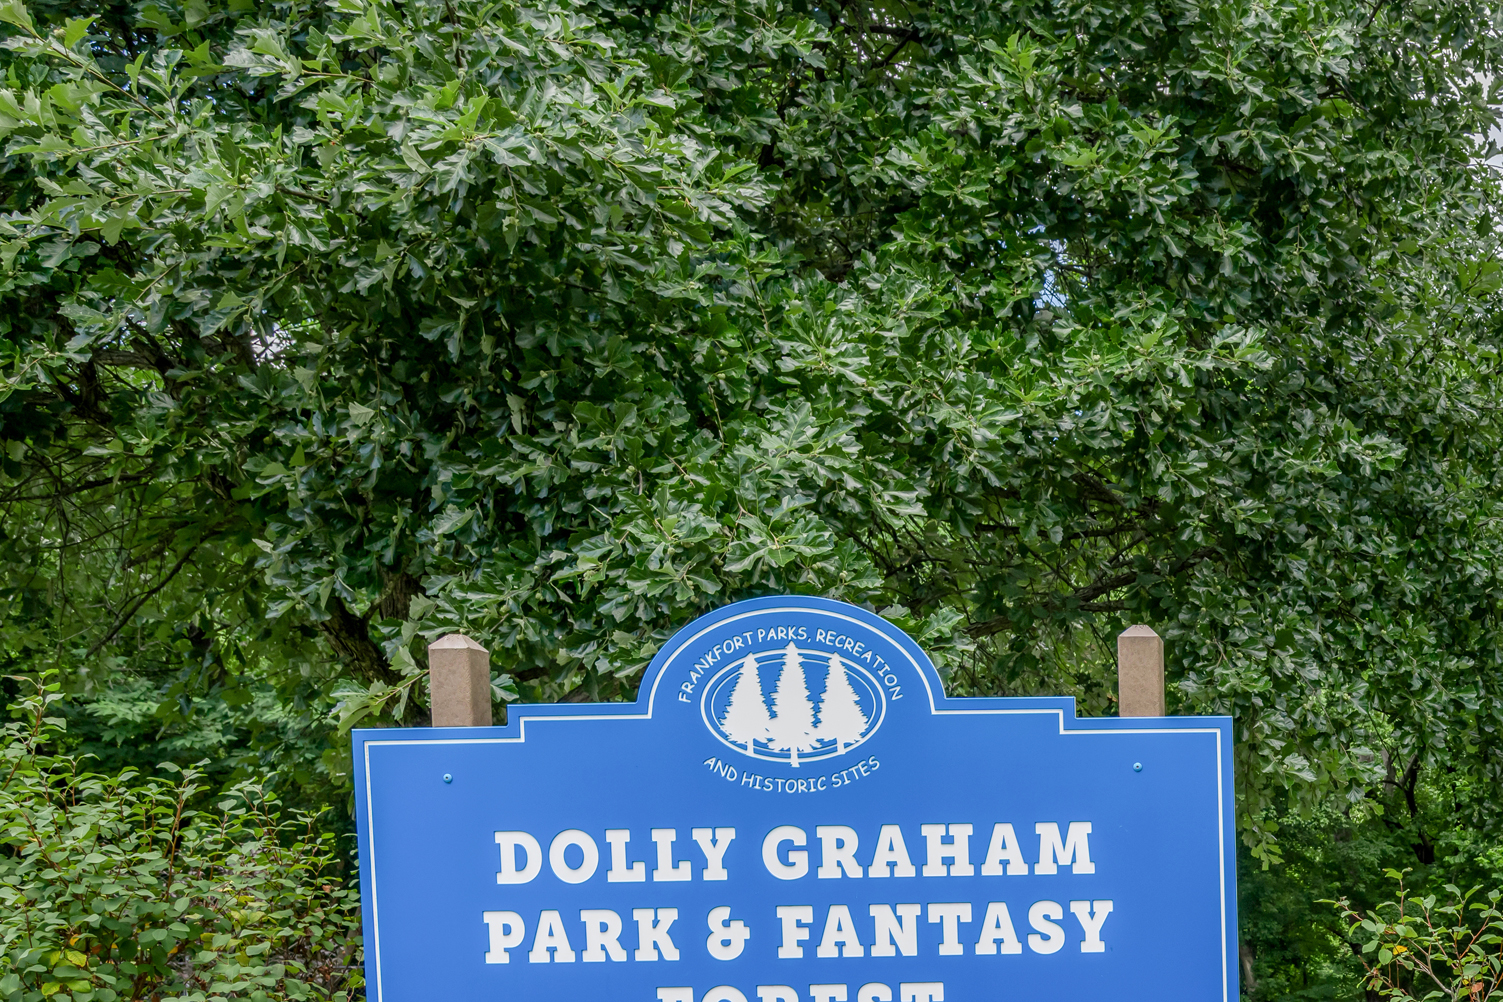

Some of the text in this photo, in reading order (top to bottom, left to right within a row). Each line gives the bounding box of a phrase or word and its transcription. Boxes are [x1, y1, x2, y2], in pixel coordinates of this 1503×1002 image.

[678, 626, 903, 703] FRANKFORT PARKS, RECREATION
[703, 756, 880, 793] AND HISTORIC SITES
[494, 821, 1096, 885] DOLLY GRAHAM
[483, 900, 1114, 964] PARK & FANTASY
